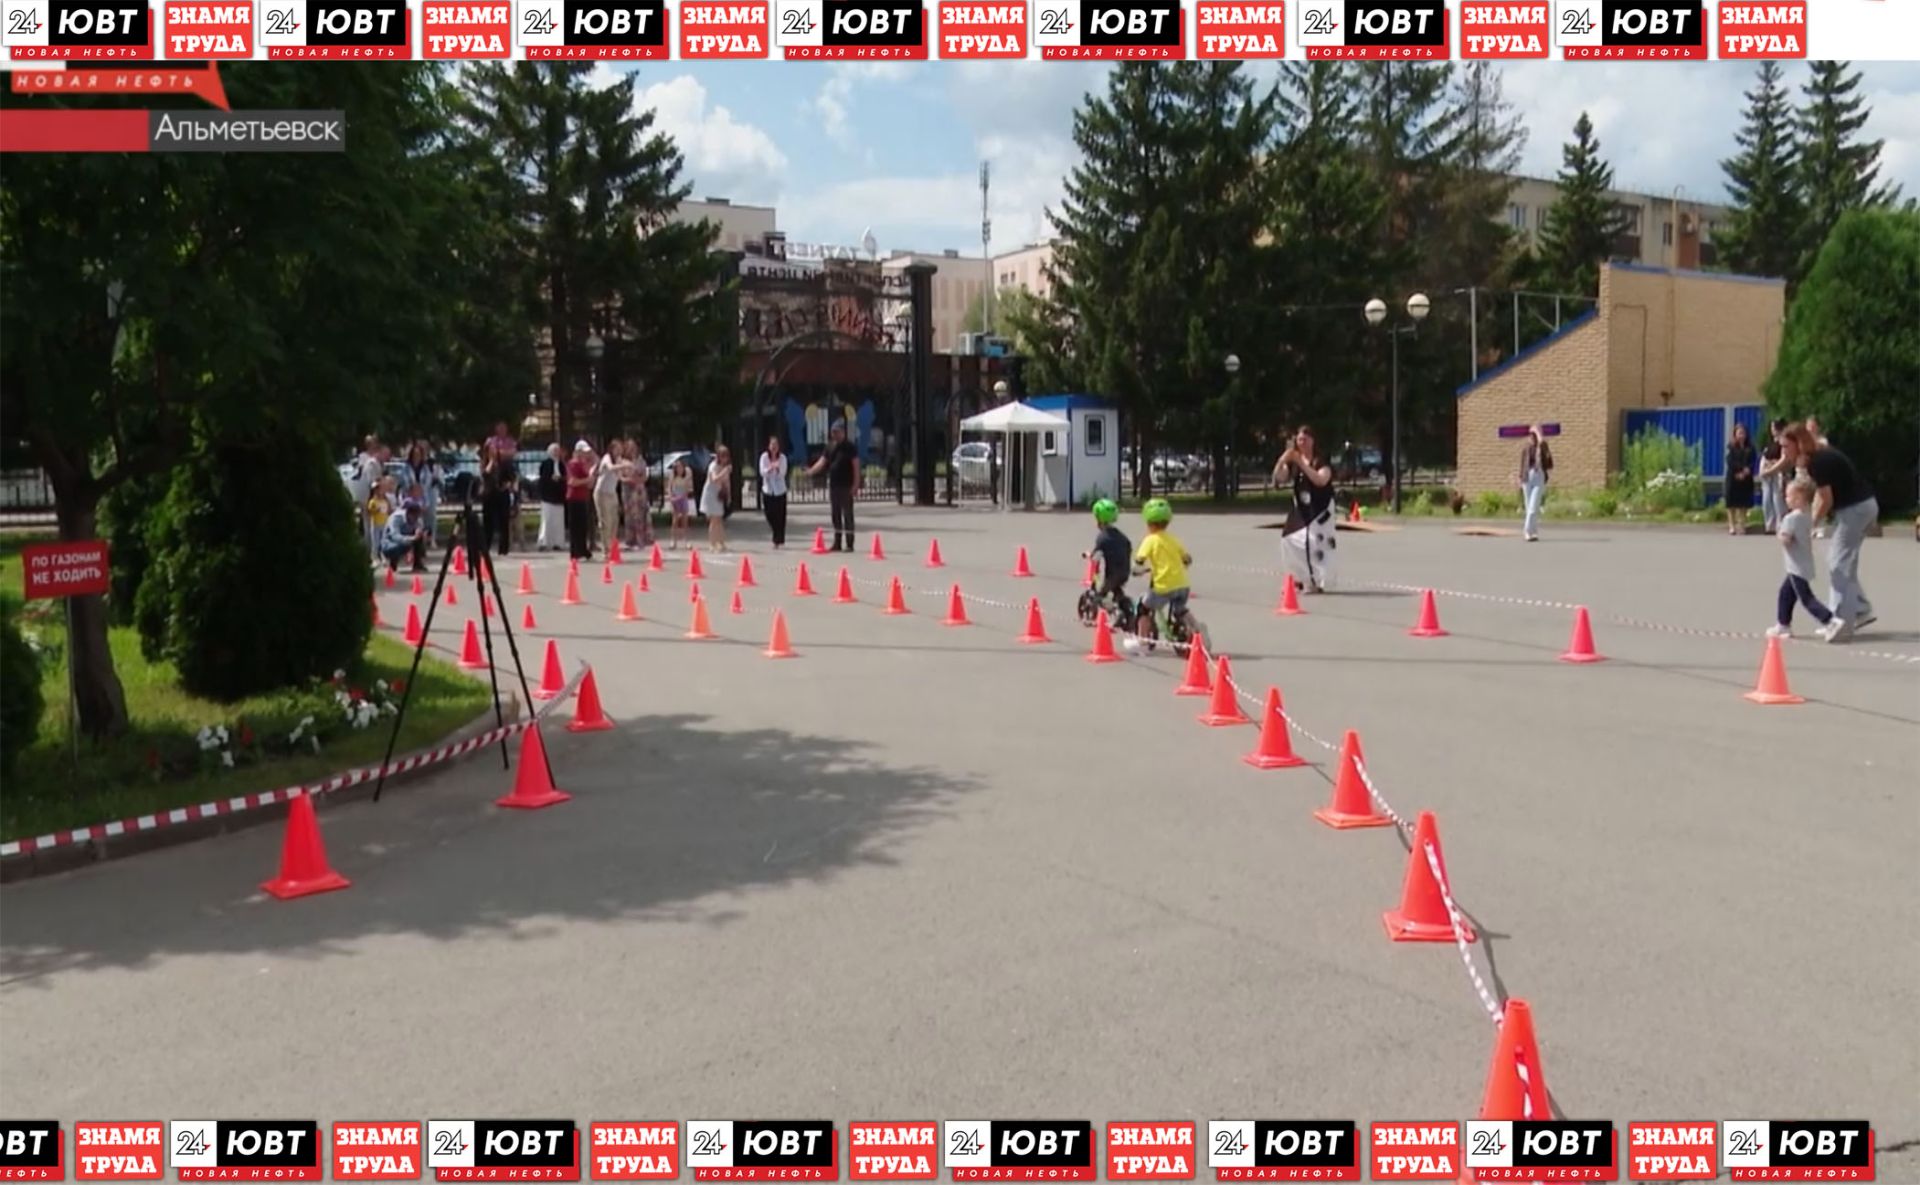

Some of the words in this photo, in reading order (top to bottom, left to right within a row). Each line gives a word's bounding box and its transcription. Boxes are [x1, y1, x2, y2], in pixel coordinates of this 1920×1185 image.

[32, 556, 49, 568] ПО
[51, 552, 101, 566] ГАЗОНАМ
[32, 571, 50, 585] НЕ
[53, 567, 102, 582] ХОДИТЬ
